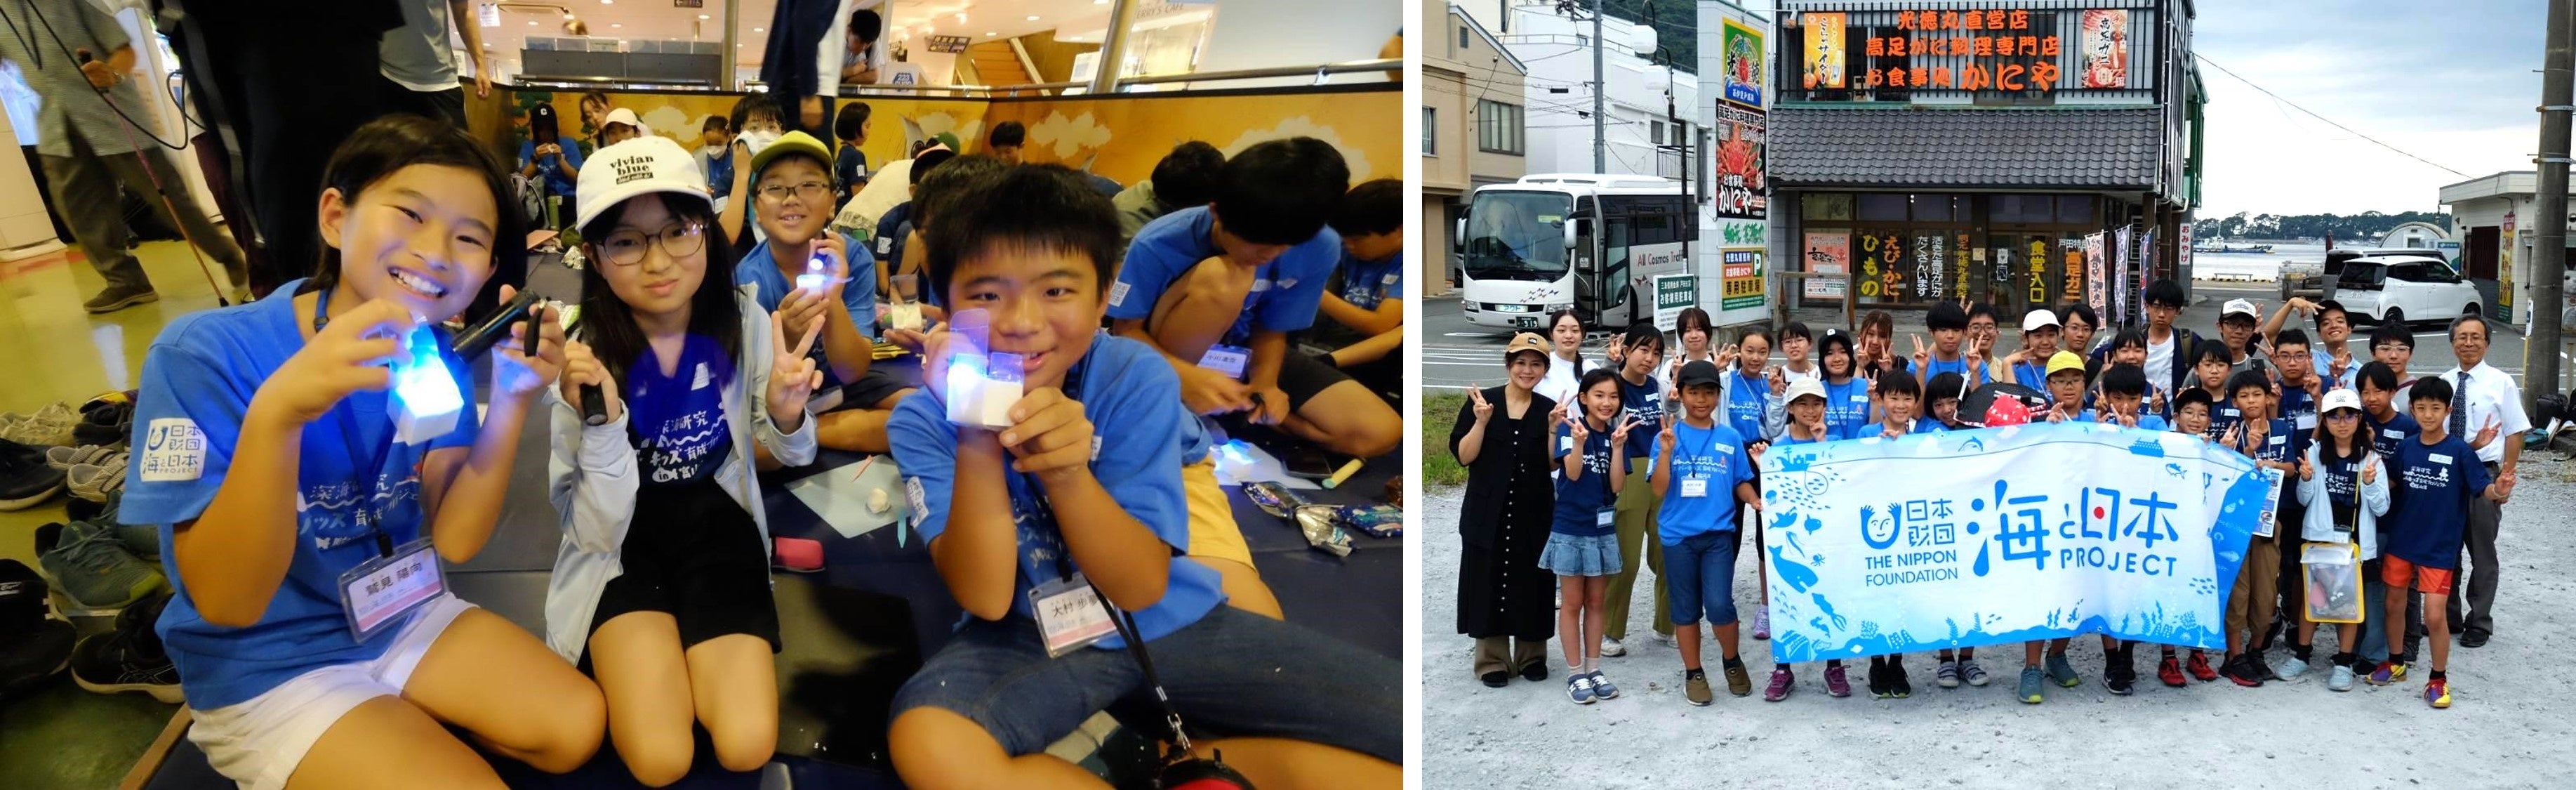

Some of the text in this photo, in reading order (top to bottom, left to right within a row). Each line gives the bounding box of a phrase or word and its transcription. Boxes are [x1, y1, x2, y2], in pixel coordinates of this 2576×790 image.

[1898, 10, 2029, 30] 光徳丸直営店
[1866, 36, 2062, 57] 高足がに料理専門店
[609, 155, 654, 169] vivian
[617, 164, 649, 176] blue
[1718, 184, 1753, 216] かにや
[2181, 225, 2189, 263] おみやげ
[1753, 253, 1762, 275] P
[1861, 235, 1880, 296] ひもの
[1917, 236, 1929, 297] たくさんいます
[2029, 239, 2045, 303] 食堂入口
[171, 425, 201, 436] 日本
[142, 453, 198, 475] 海と日本
[1906, 498, 1953, 522] 日本
[1908, 523, 1955, 547] 財団
[1967, 480, 2179, 577] 海と日本
[1865, 549, 1957, 570] THE NIPPON
[2061, 546, 2177, 577] PROJECT
[1866, 567, 1958, 587] FOUNDATION
